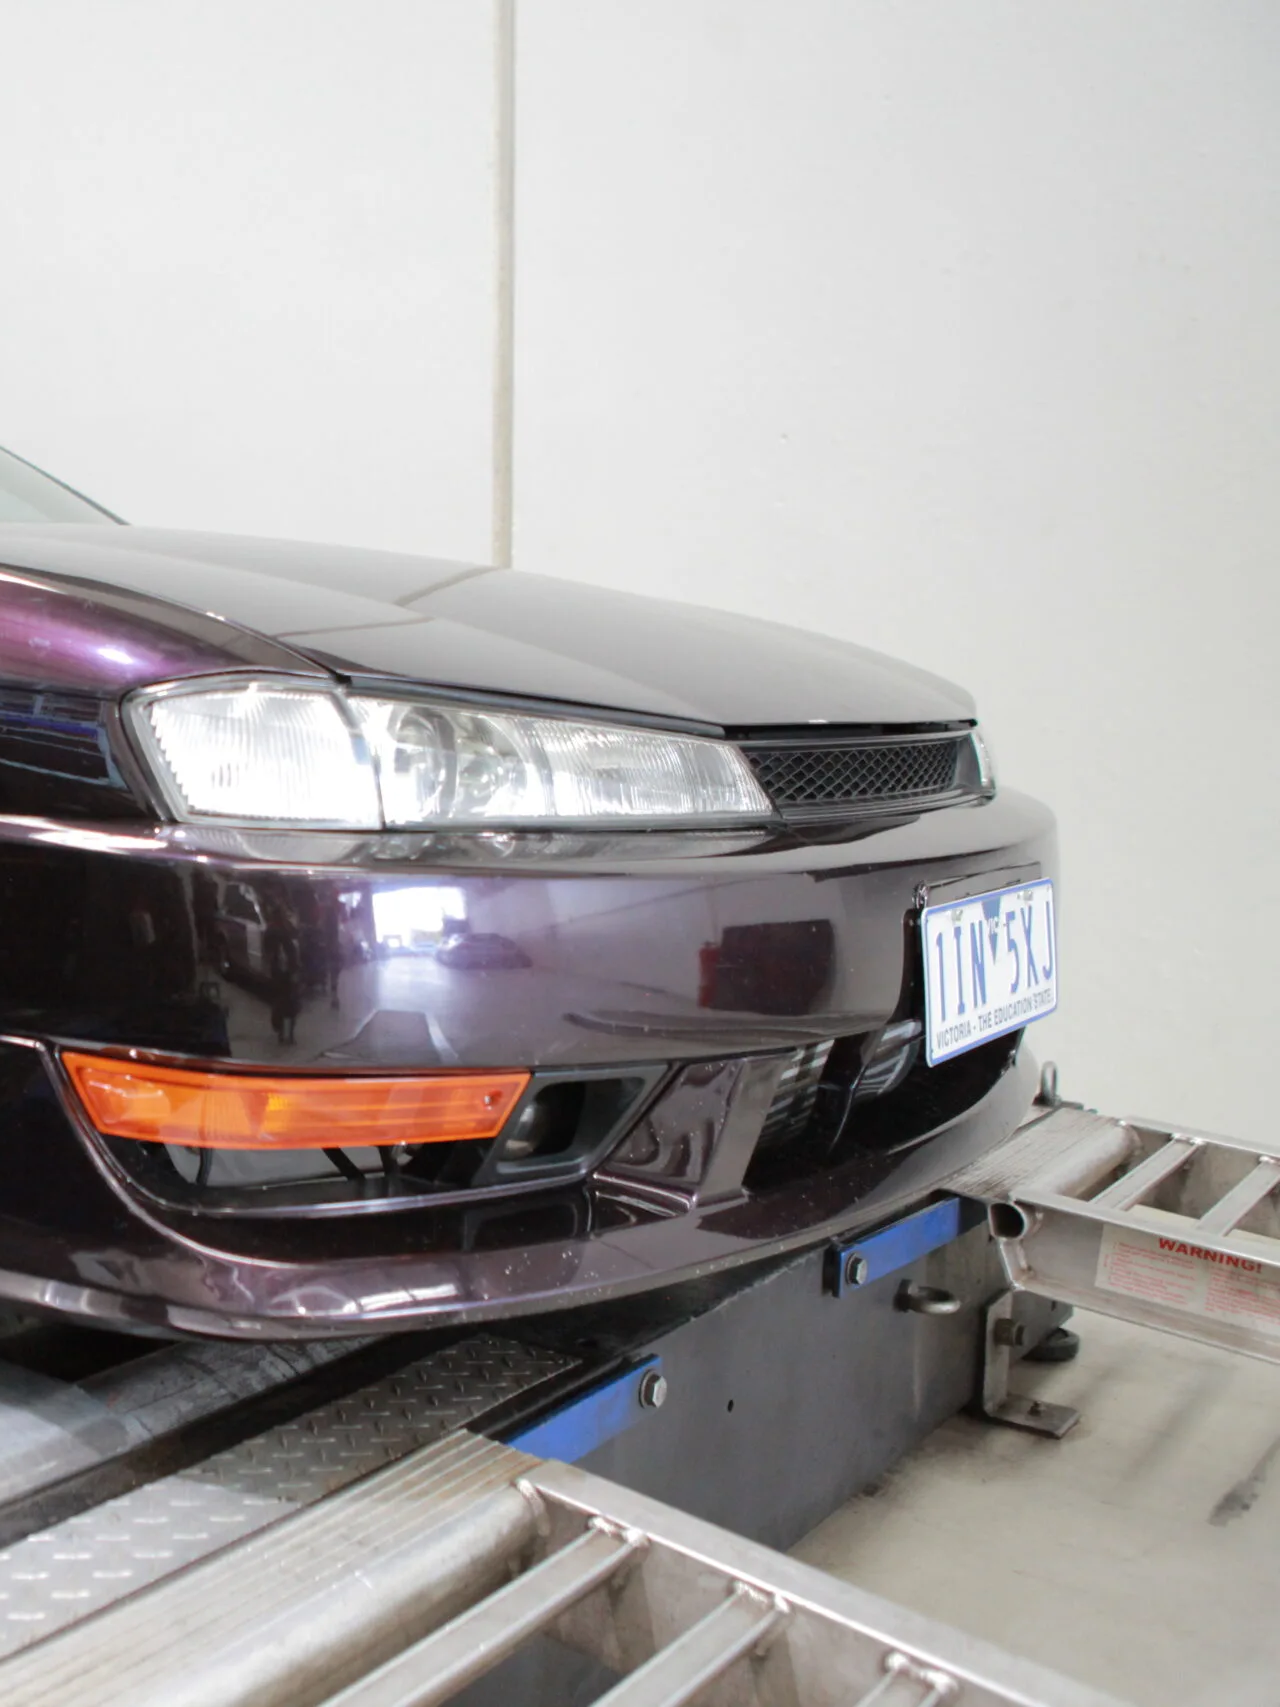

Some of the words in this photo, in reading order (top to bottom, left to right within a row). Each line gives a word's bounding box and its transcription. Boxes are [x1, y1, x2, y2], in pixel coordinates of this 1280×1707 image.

[936, 1019, 972, 1050] VICTORIA
[977, 1010, 993, 1033] THE
[993, 995, 1033, 1026] EDUCATION
[1158, 1237, 1263, 1274] WARNING!
